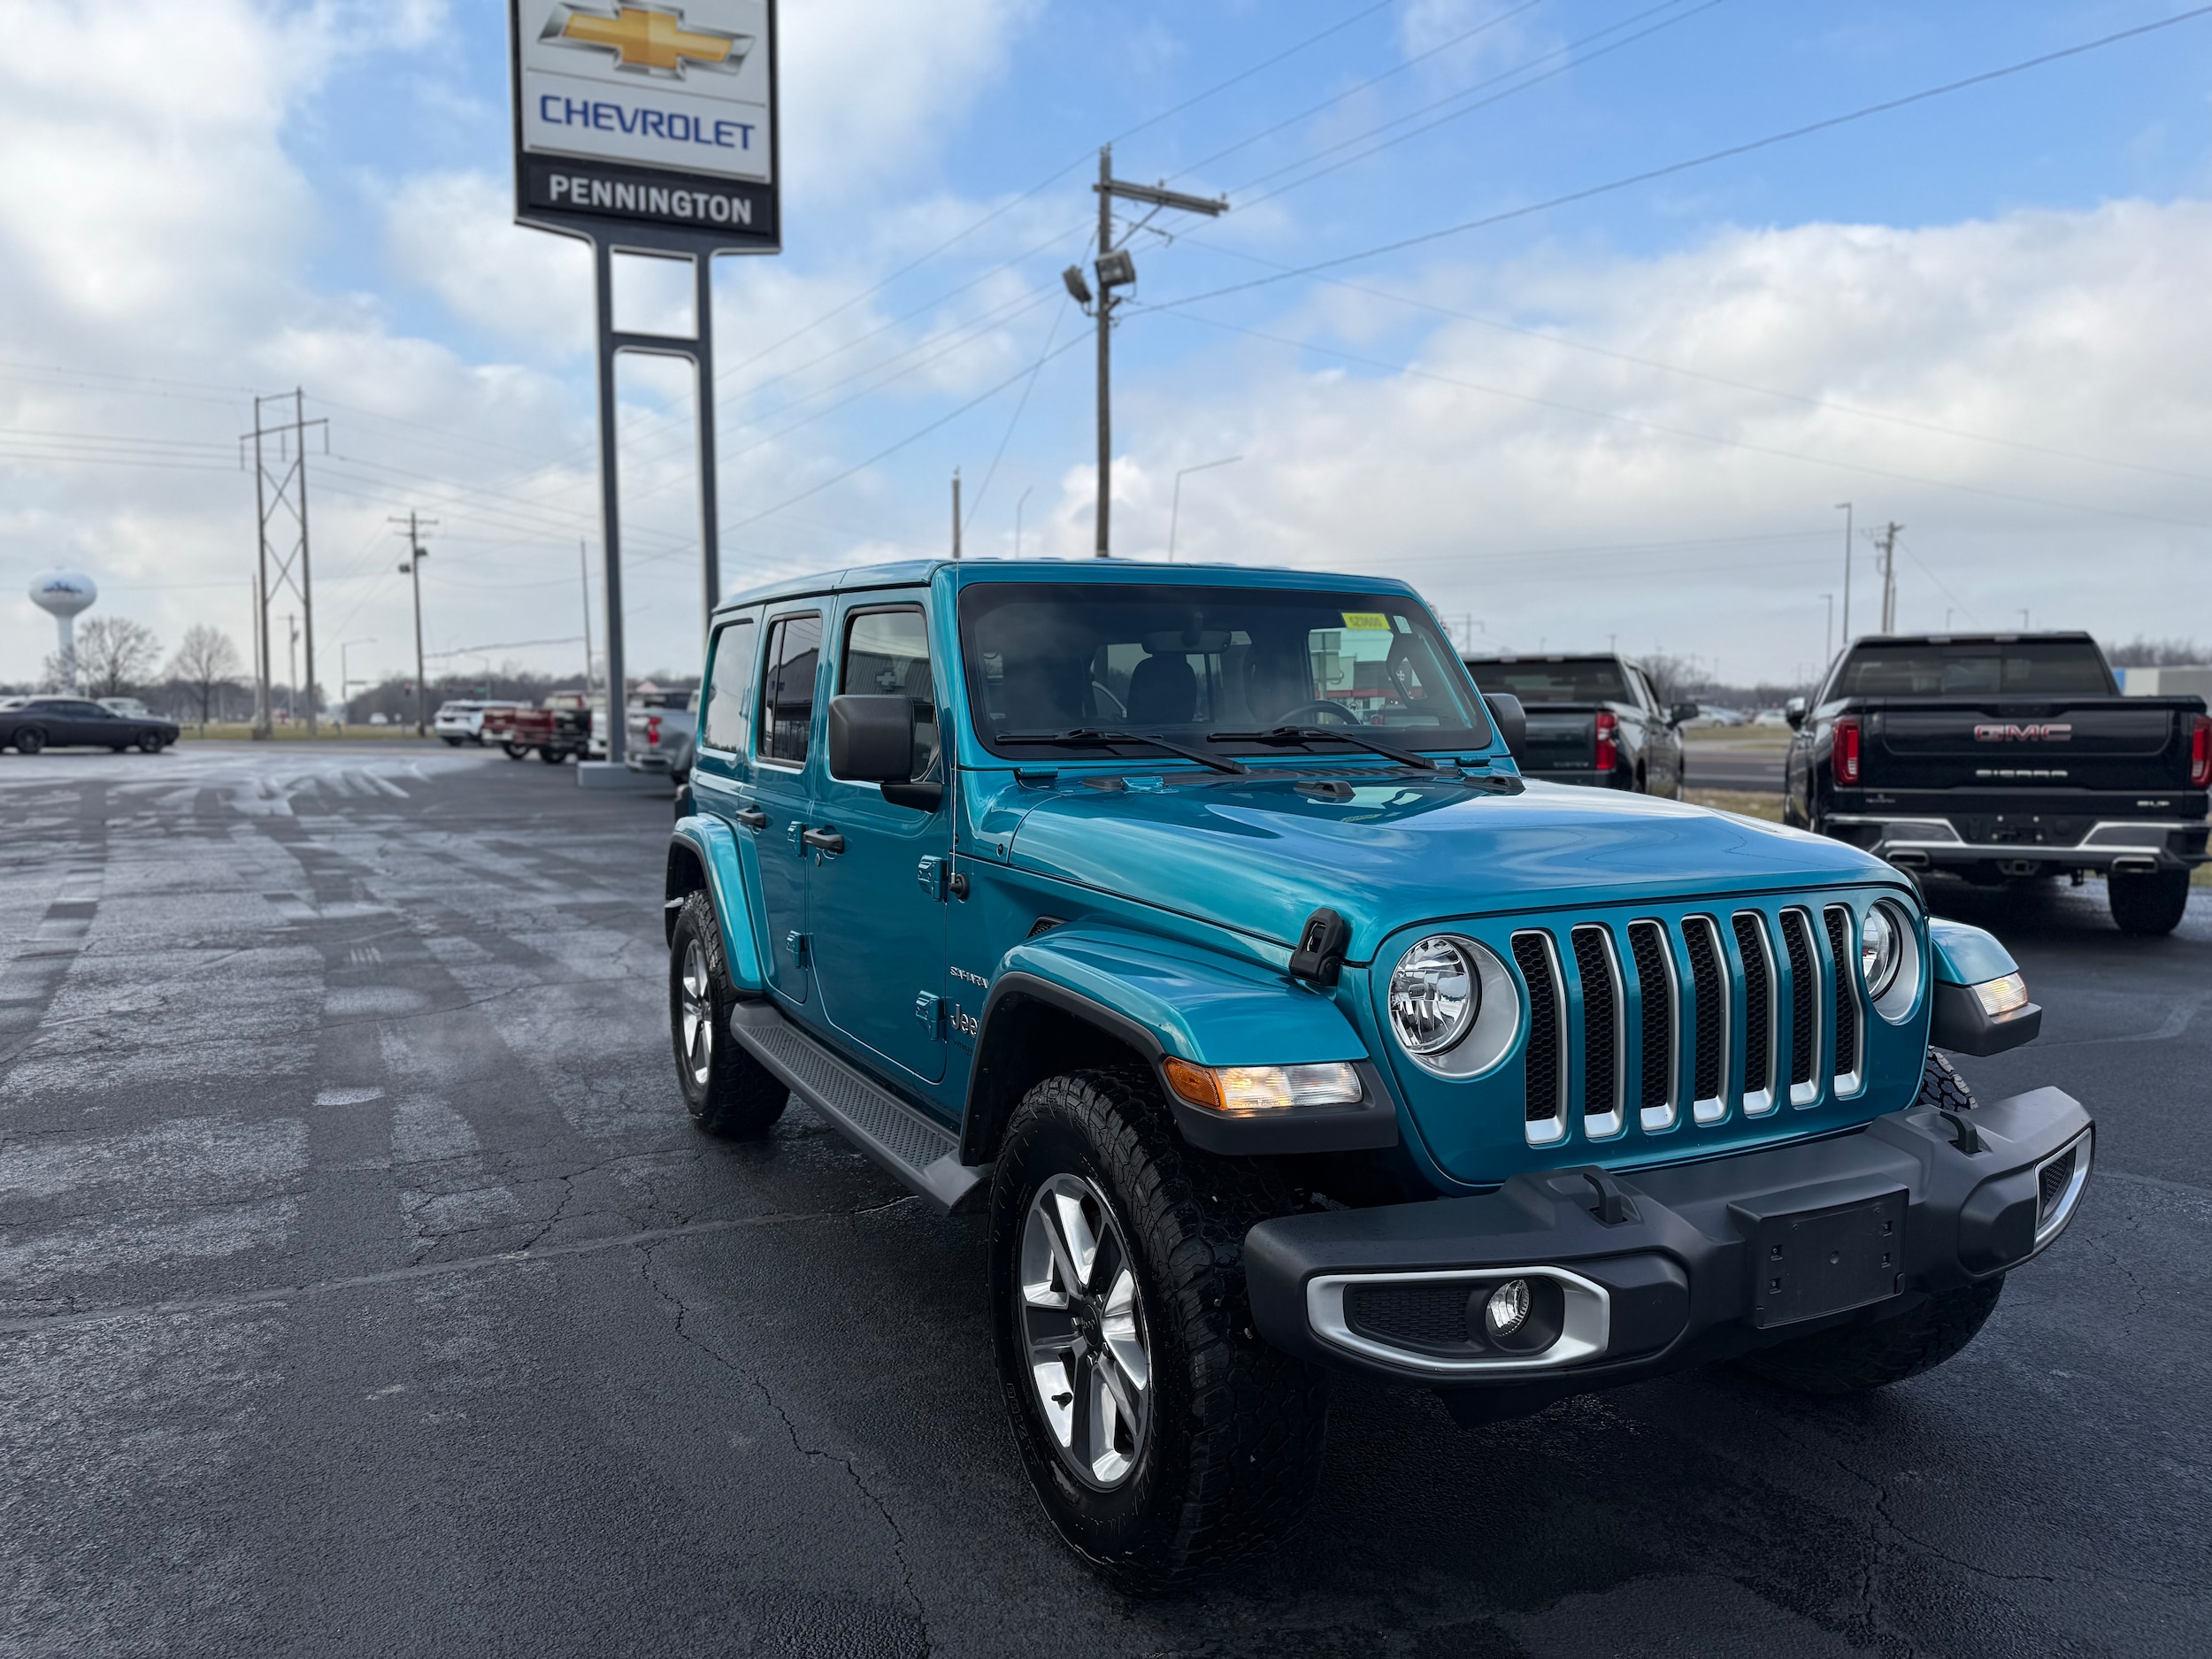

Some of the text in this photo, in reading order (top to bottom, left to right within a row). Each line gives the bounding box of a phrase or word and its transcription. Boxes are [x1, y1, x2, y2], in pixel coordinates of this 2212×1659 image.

[540, 95, 755, 150] CHEVROLET
[549, 174, 751, 223] PENNINGTON
[1974, 724, 2071, 741] GMC
[949, 965, 989, 989] SAHARA
[950, 1003, 979, 1038] Jee
